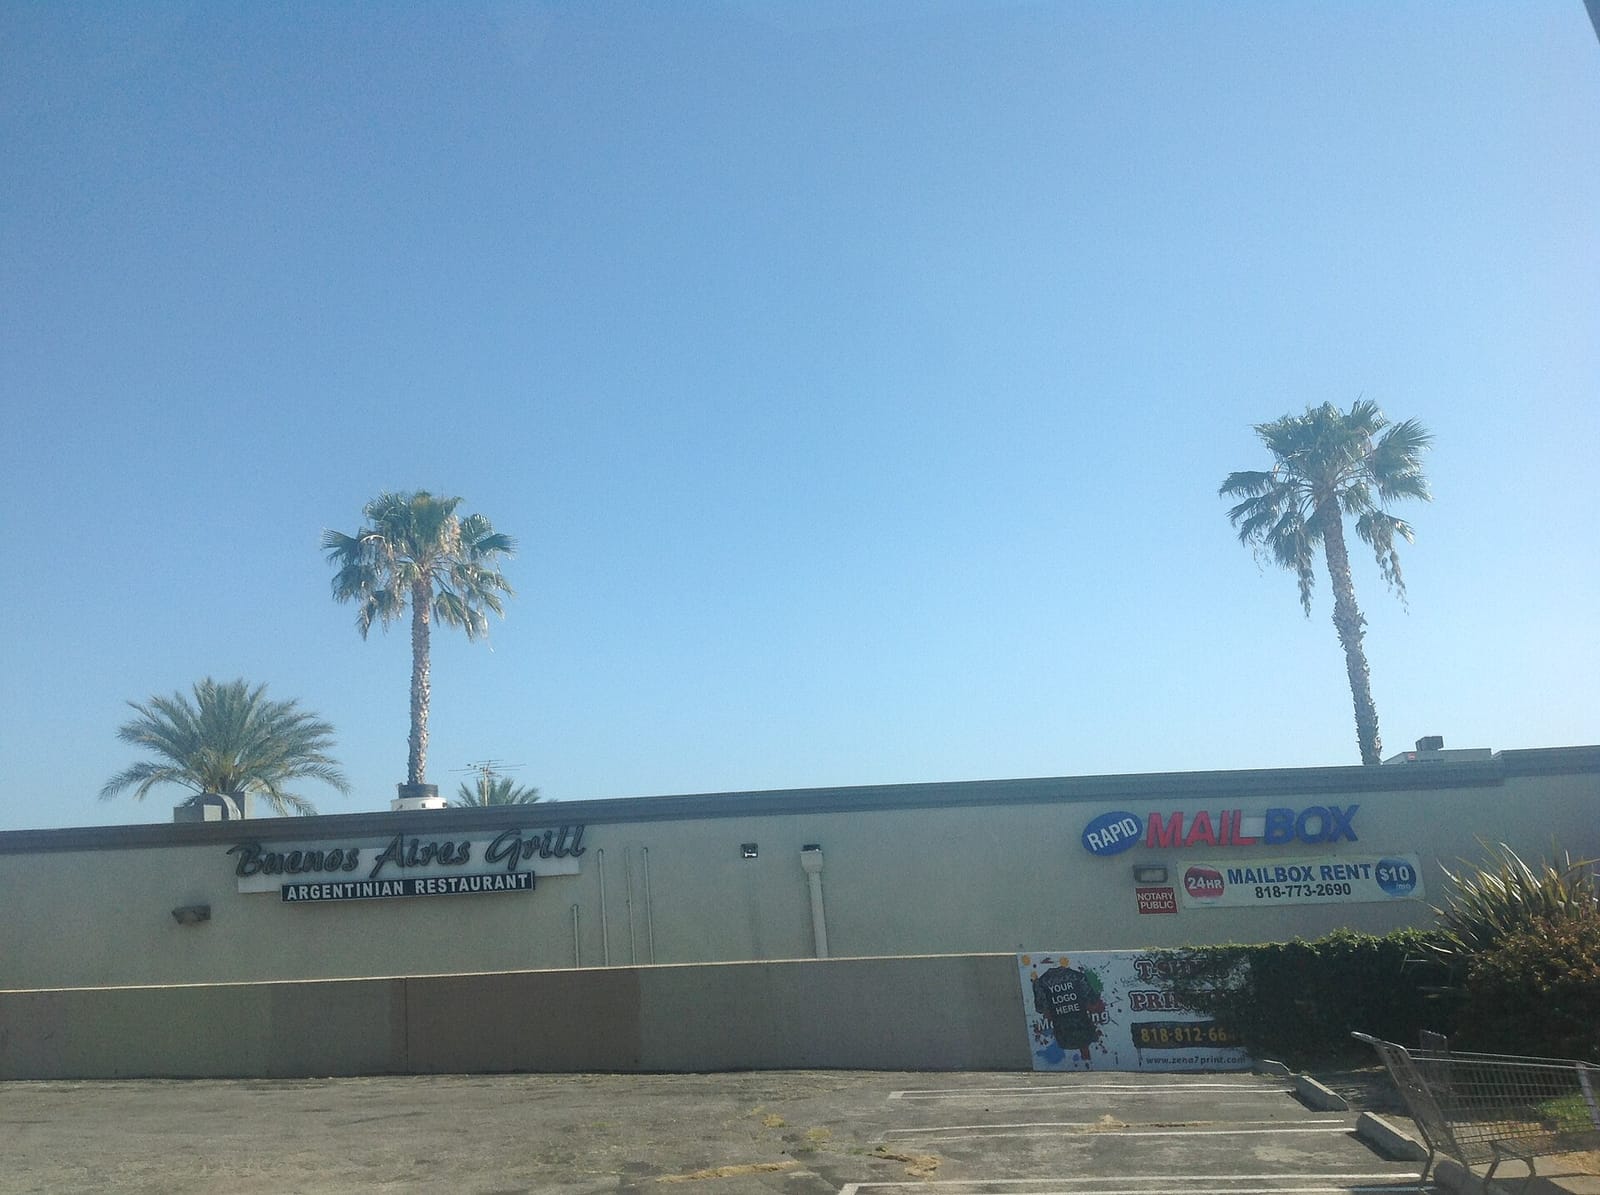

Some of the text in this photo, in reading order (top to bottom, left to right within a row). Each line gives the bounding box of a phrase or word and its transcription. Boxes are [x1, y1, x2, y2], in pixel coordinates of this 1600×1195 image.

[1263, 804, 1361, 845] BOX
[1087, 818, 1139, 852] RAPID
[227, 824, 586, 879] Buenos Aires Grill
[1227, 863, 1371, 885] MAILBOX RENT
[1379, 866, 1410, 882] $10
[286, 872, 529, 901] ARGENTINIAN RESTAURANT
[1187, 876, 1222, 890] 24HR
[1255, 882, 1352, 899] 818-773-2690
[1137, 892, 1173, 901] NOTARY
[1140, 901, 1173, 910] PUBLIC
[1048, 982, 1074, 994] YOUR
[1052, 992, 1077, 1005] LOGO
[1055, 1003, 1080, 1015] HERE
[1141, 1026, 1230, 1043] 818-812-66
